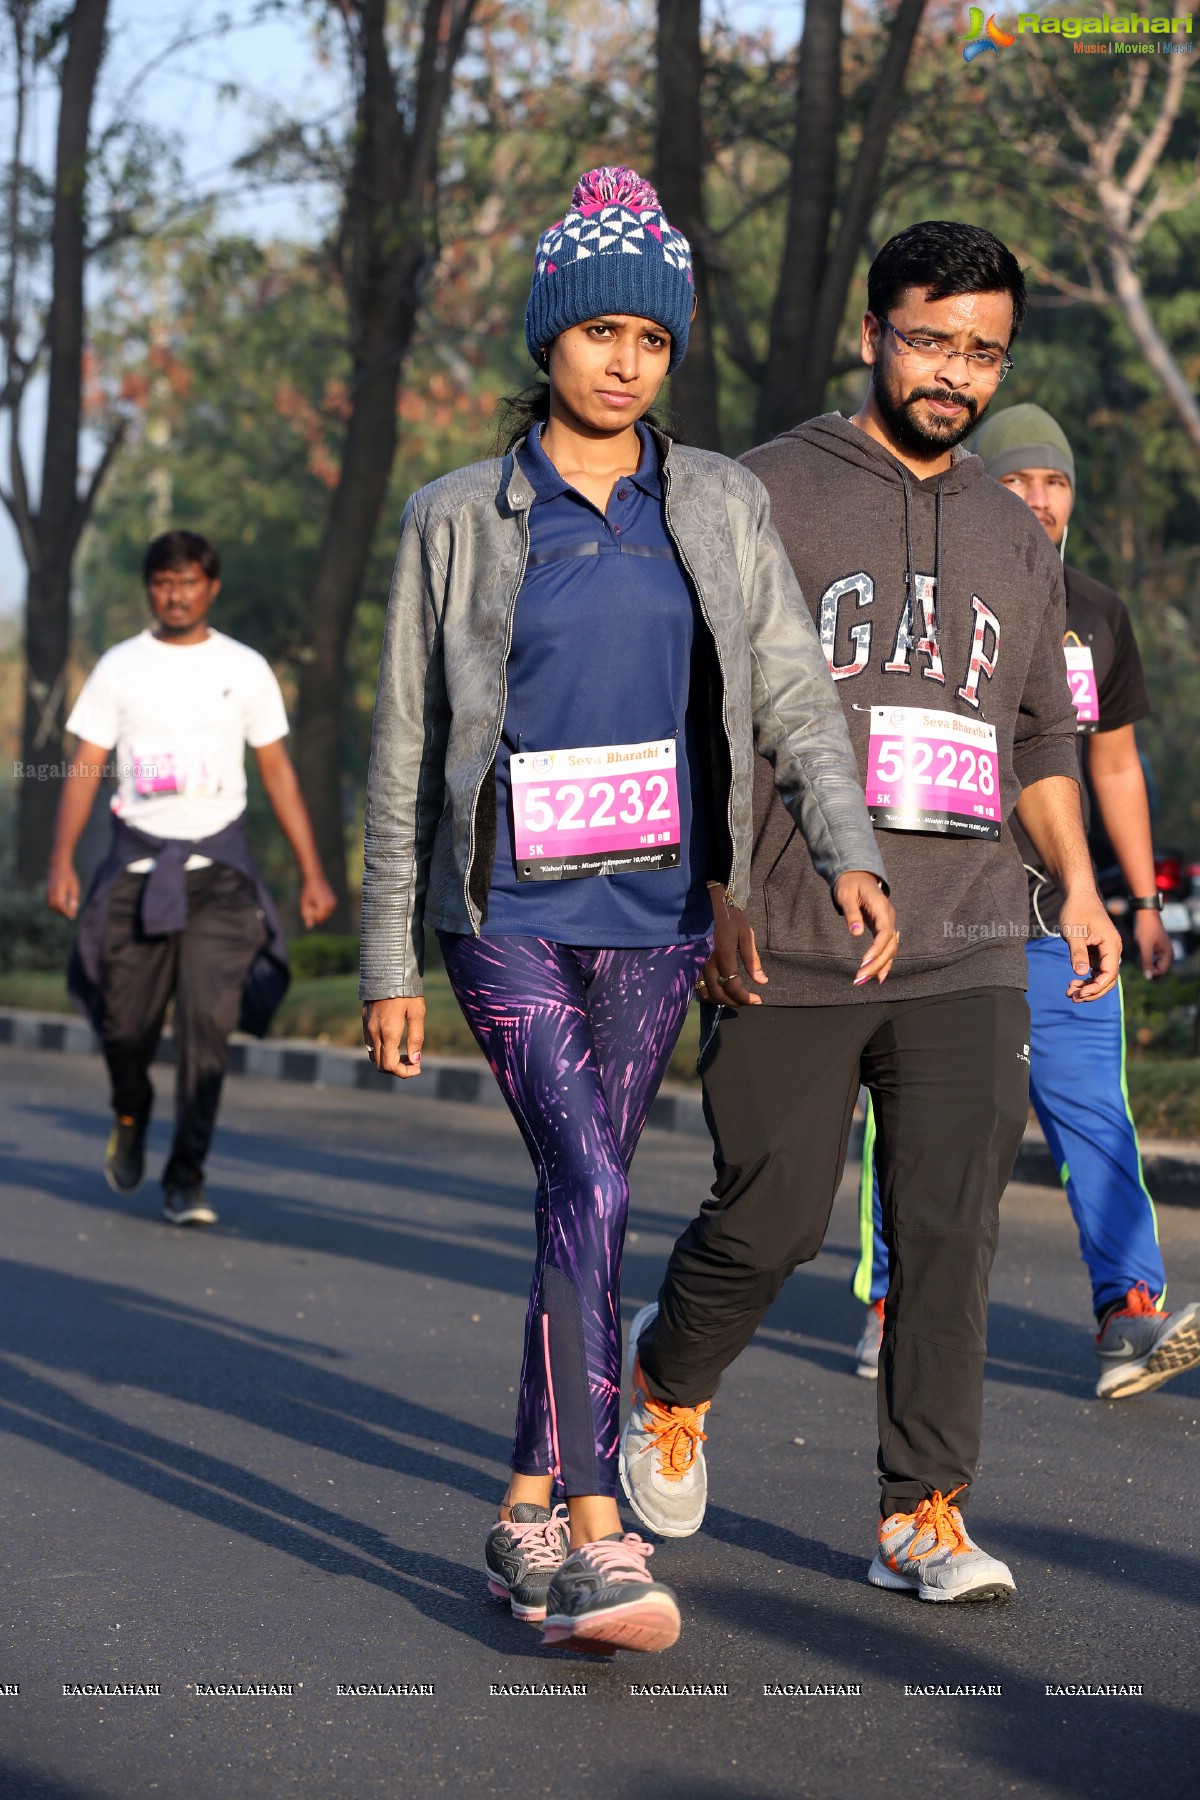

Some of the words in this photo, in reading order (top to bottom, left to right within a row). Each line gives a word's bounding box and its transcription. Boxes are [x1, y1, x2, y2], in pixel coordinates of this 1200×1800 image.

[817, 570, 1001, 711] GAP
[1067, 671, 1093, 704] 2
[923, 715, 950, 730] Seva
[952, 719, 987, 740] Bharathi
[567, 754, 602, 767] Seva
[606, 746, 660, 764] Bharathi
[875, 740, 995, 796] 52228
[524, 775, 672, 833] 52232
[876, 793, 891, 804] 5K
[528, 844, 545, 856] 5K
